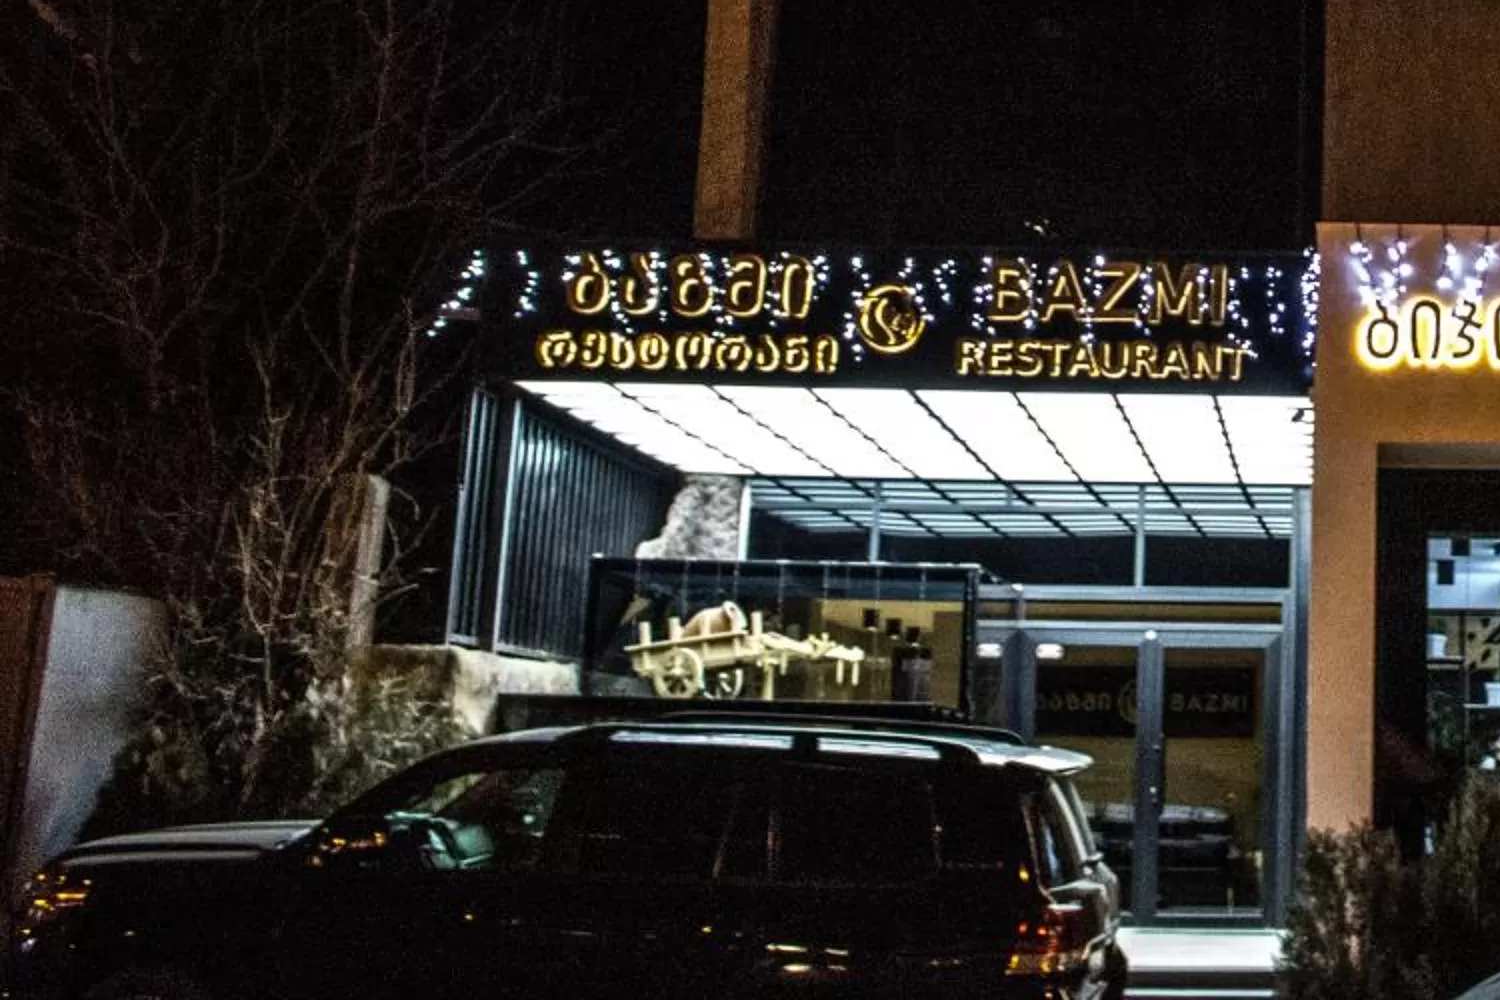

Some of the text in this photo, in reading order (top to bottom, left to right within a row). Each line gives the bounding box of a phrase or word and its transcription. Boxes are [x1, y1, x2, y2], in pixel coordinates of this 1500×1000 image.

[565, 252, 816, 318] ბაზმი
[987, 257, 1229, 327] BAZMI
[537, 331, 840, 374] რესტორანი
[956, 339, 1252, 382] RESTAURANT
[1168, 692, 1248, 714] BAZMI
